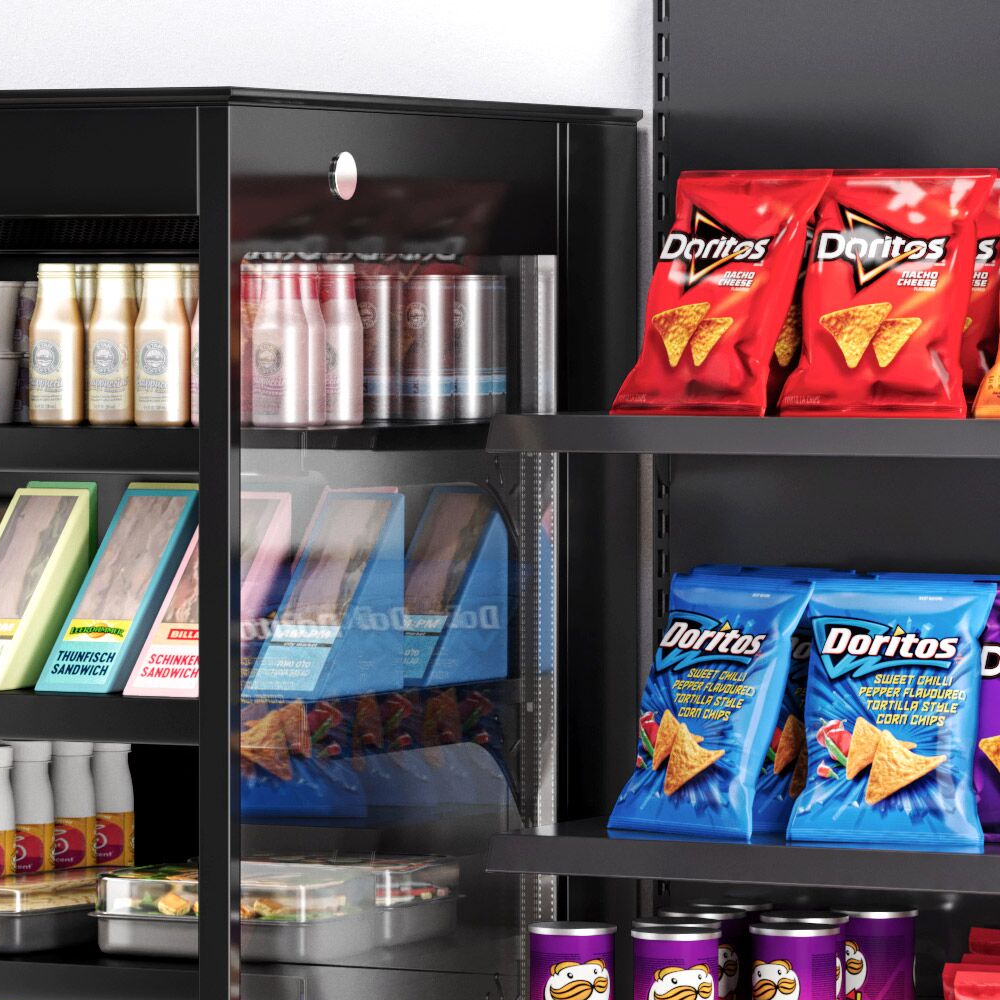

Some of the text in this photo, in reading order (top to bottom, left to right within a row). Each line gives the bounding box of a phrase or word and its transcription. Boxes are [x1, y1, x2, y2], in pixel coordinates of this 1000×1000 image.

[660, 233, 770, 260] Doritos
[817, 232, 946, 261] Doritos
[723, 271, 756, 279] NACHO
[902, 271, 939, 279] NACHO
[718, 279, 753, 287] CHEESE
[897, 278, 938, 287] CHEESE
[660, 621, 766, 655] Doritos
[822, 627, 959, 659] Doritos
[56, 650, 116, 663] THUNFISCH
[51, 664, 109, 676] SANDWICH
[141, 666, 199, 679] SANDWICH
[688, 668, 748, 682] SWEET CHILLI
[874, 674, 953, 687] SWEET CHILLI
[672, 680, 756, 696] PEPPER FLAVOURED
[859, 687, 966, 700] PEPPER FLAVOURED
[673, 693, 744, 709] TORTILLA STYLE
[866, 700, 957, 713] TORTILLA STYLE
[678, 707, 731, 721] CORN CHIPS
[876, 714, 945, 726] CORN CHIPS
